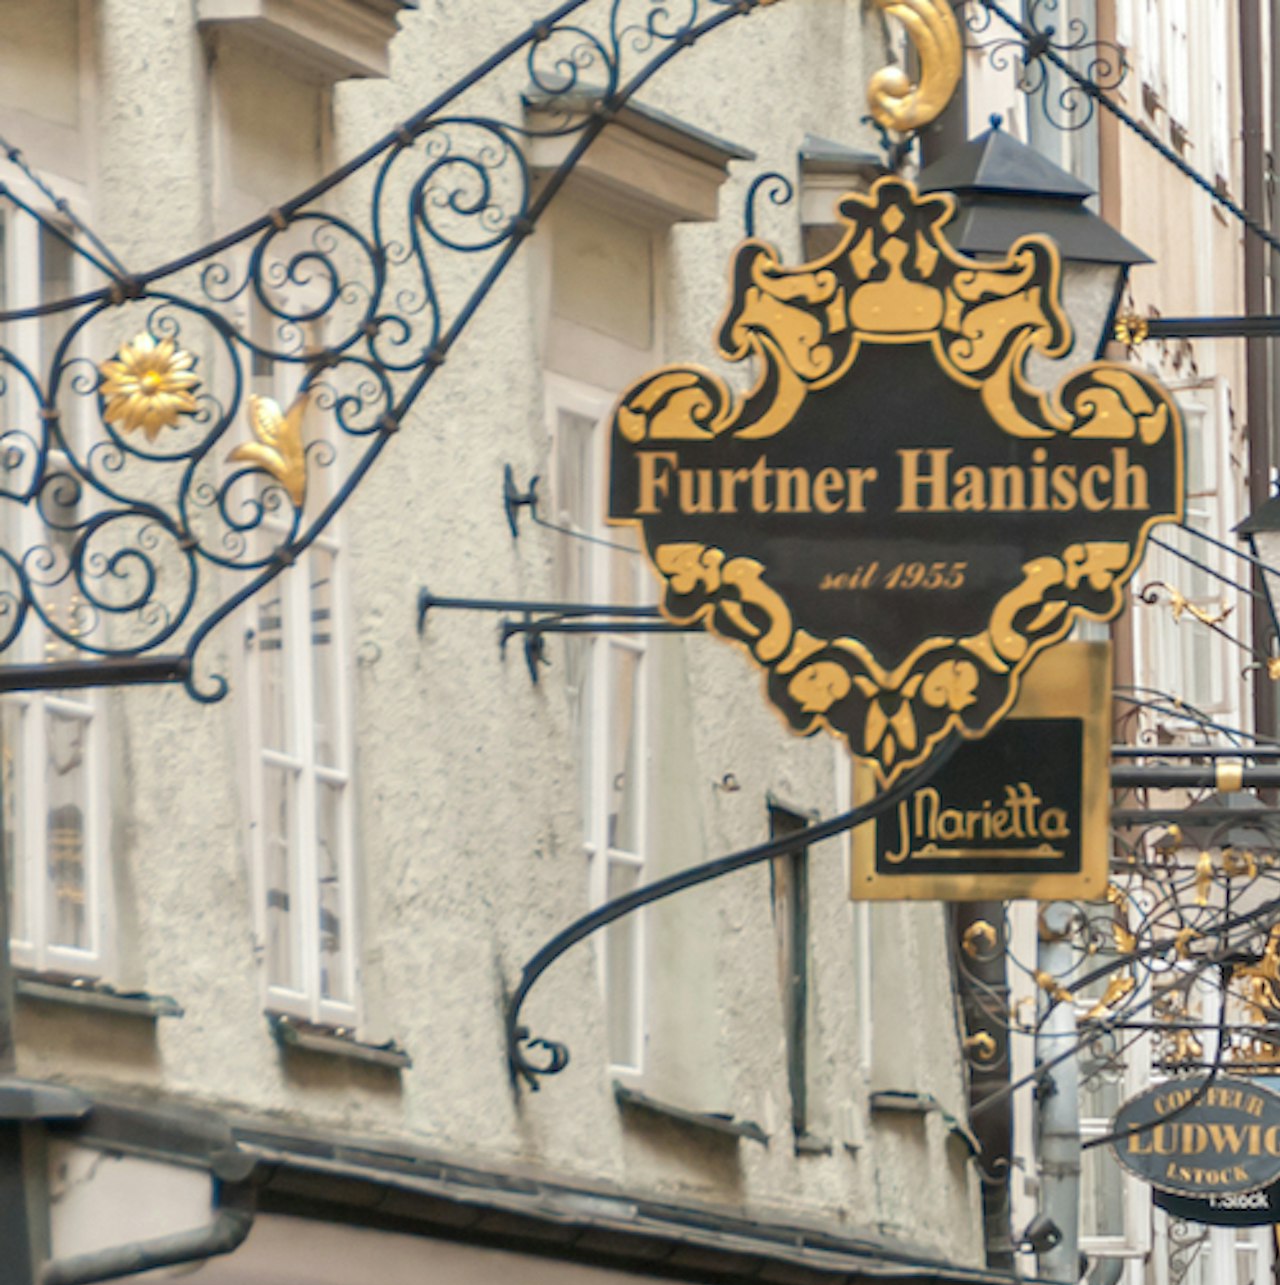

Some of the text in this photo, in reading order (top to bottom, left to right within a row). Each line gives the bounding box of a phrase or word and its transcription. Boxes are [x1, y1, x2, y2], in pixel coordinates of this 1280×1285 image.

[634, 446, 1149, 514] Furtner Hanisch
[819, 559, 968, 591] seit 1955
